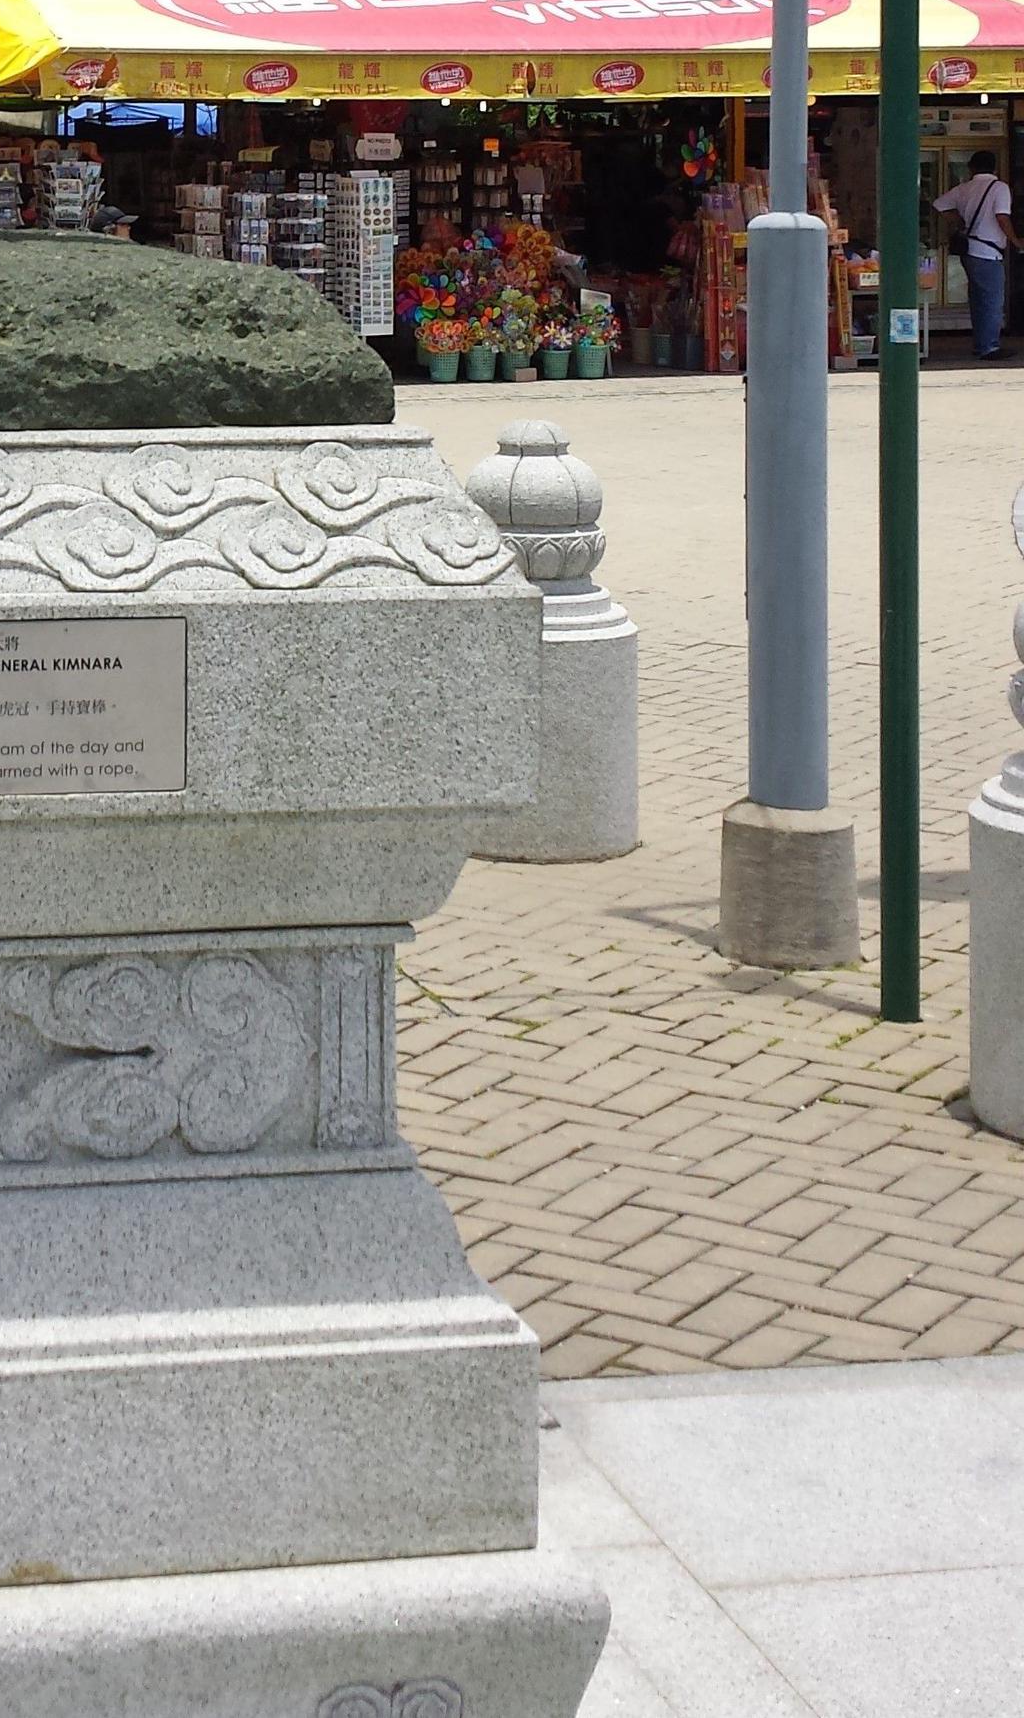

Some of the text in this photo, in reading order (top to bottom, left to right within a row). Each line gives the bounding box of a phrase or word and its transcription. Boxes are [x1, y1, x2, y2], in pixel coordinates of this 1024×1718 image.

[52, 657, 123, 671] KIMNARA
[29, 741, 46, 755] of
[50, 740, 75, 754] the
[80, 740, 109, 755] day
[114, 739, 145, 753] and
[48, 763, 79, 777] with
[83, 766, 94, 776] a
